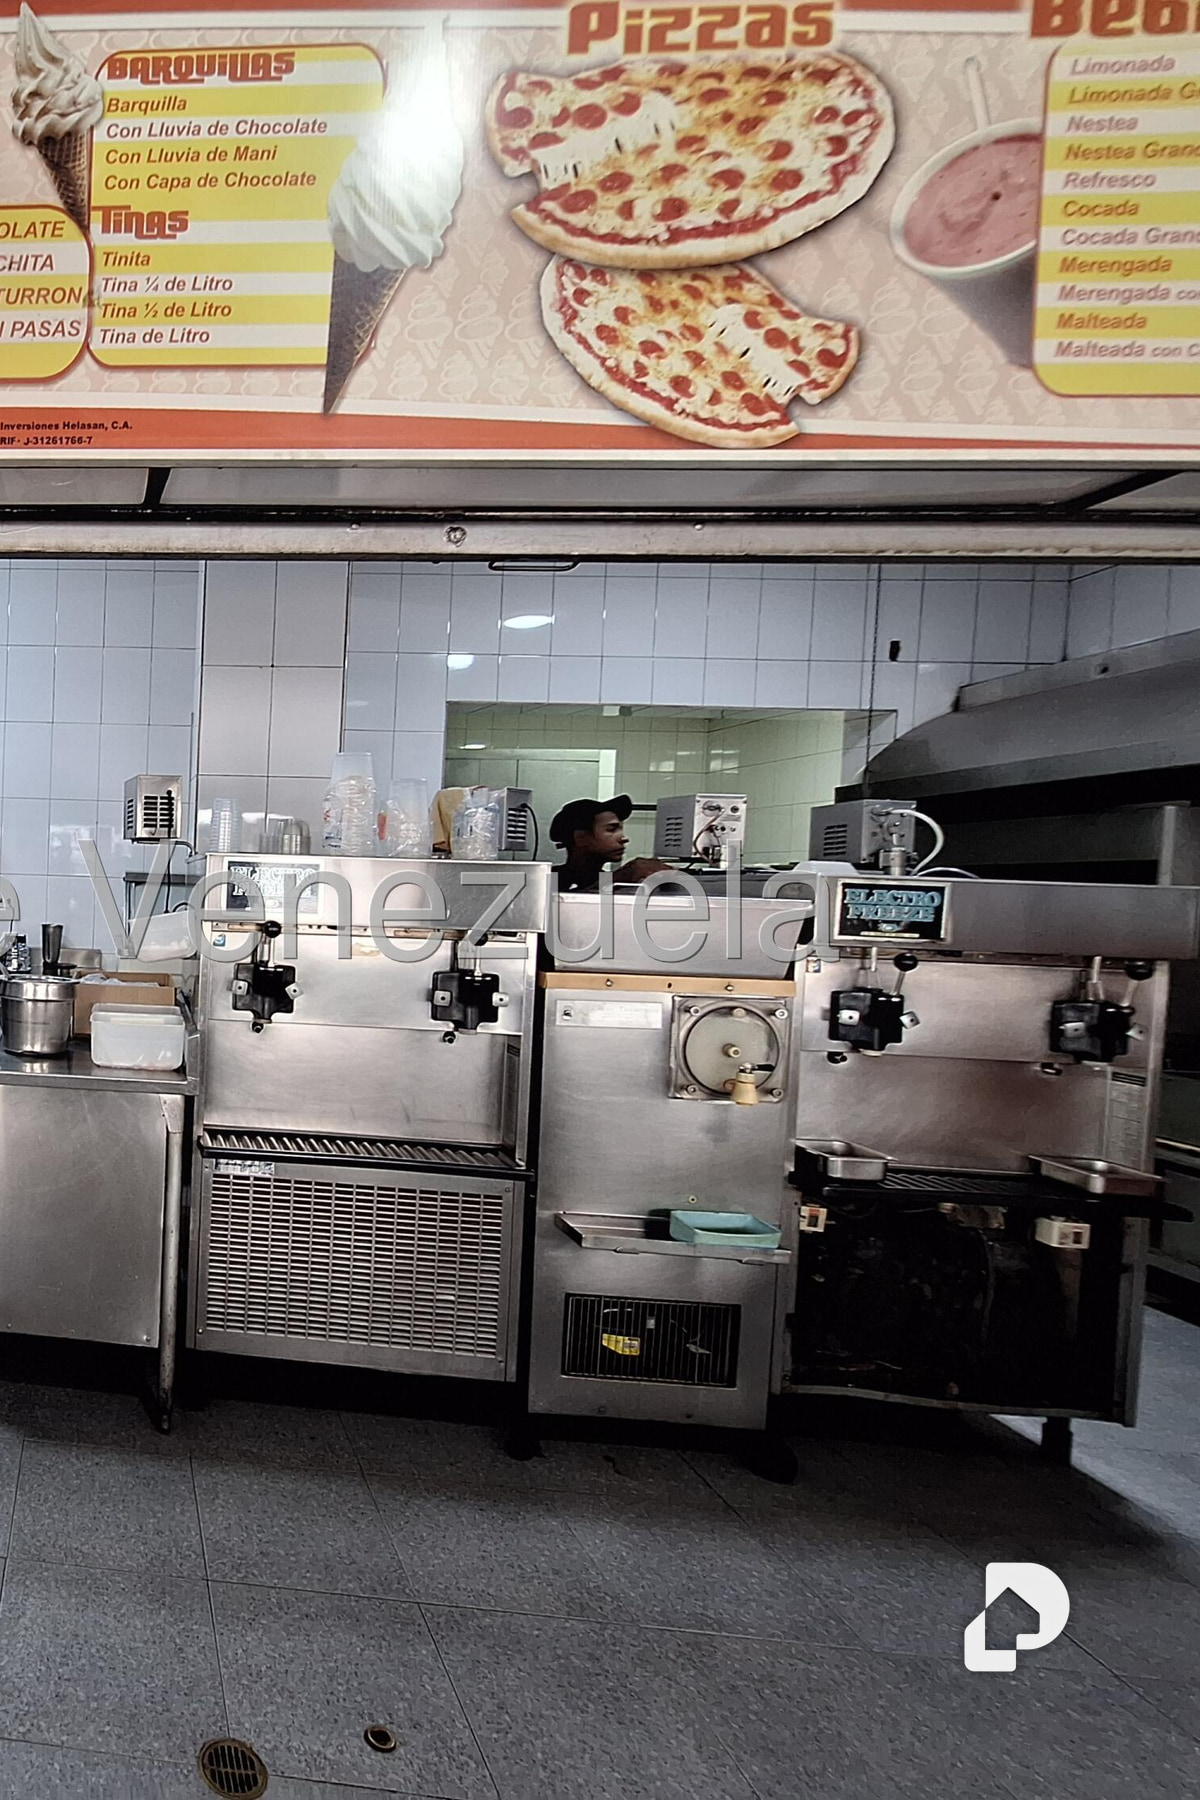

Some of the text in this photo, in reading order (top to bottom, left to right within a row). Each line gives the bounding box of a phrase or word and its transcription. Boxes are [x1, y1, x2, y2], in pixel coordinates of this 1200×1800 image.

[567, 1, 834, 55] Pizzas
[1031, 0, 1200, 38] Beb
[1071, 55, 1176, 75] Limonada
[1069, 83, 1173, 104] Limonada
[106, 96, 188, 115] Barquilla
[106, 118, 328, 138] Con Lluvia de Chocolate
[1066, 115, 1139, 132] Nestea
[105, 145, 278, 165] Con Lluvia de Mani
[1064, 143, 1136, 161] Nestea
[104, 171, 317, 192] Con Capa de Chocolate
[1063, 171, 1156, 189] Refresco
[1062, 199, 1140, 218] Cocada
[1061, 228, 1138, 245] Cocada
[102, 250, 151, 267] Tinita
[1059, 255, 1173, 277] Merengada
[102, 276, 138, 293] Tina
[164, 275, 186, 292] de
[191, 275, 233, 292] Litro
[1058, 284, 1172, 305] Merengada
[100, 302, 136, 319] Tina
[163, 301, 185, 318] de
[190, 301, 232, 318] Litro
[10, 319, 82, 338] PASAS
[1056, 311, 1147, 330] Malteada
[100, 327, 210, 344] Tina de Litro
[1055, 341, 1146, 358] Malteada
[1151, 345, 1182, 357] con
[0, 421, 60, 431] Inversiones
[111, 420, 133, 430] C.A.
[844, 888, 942, 907] ELECTRO
[846, 904, 936, 922] FREEZE
